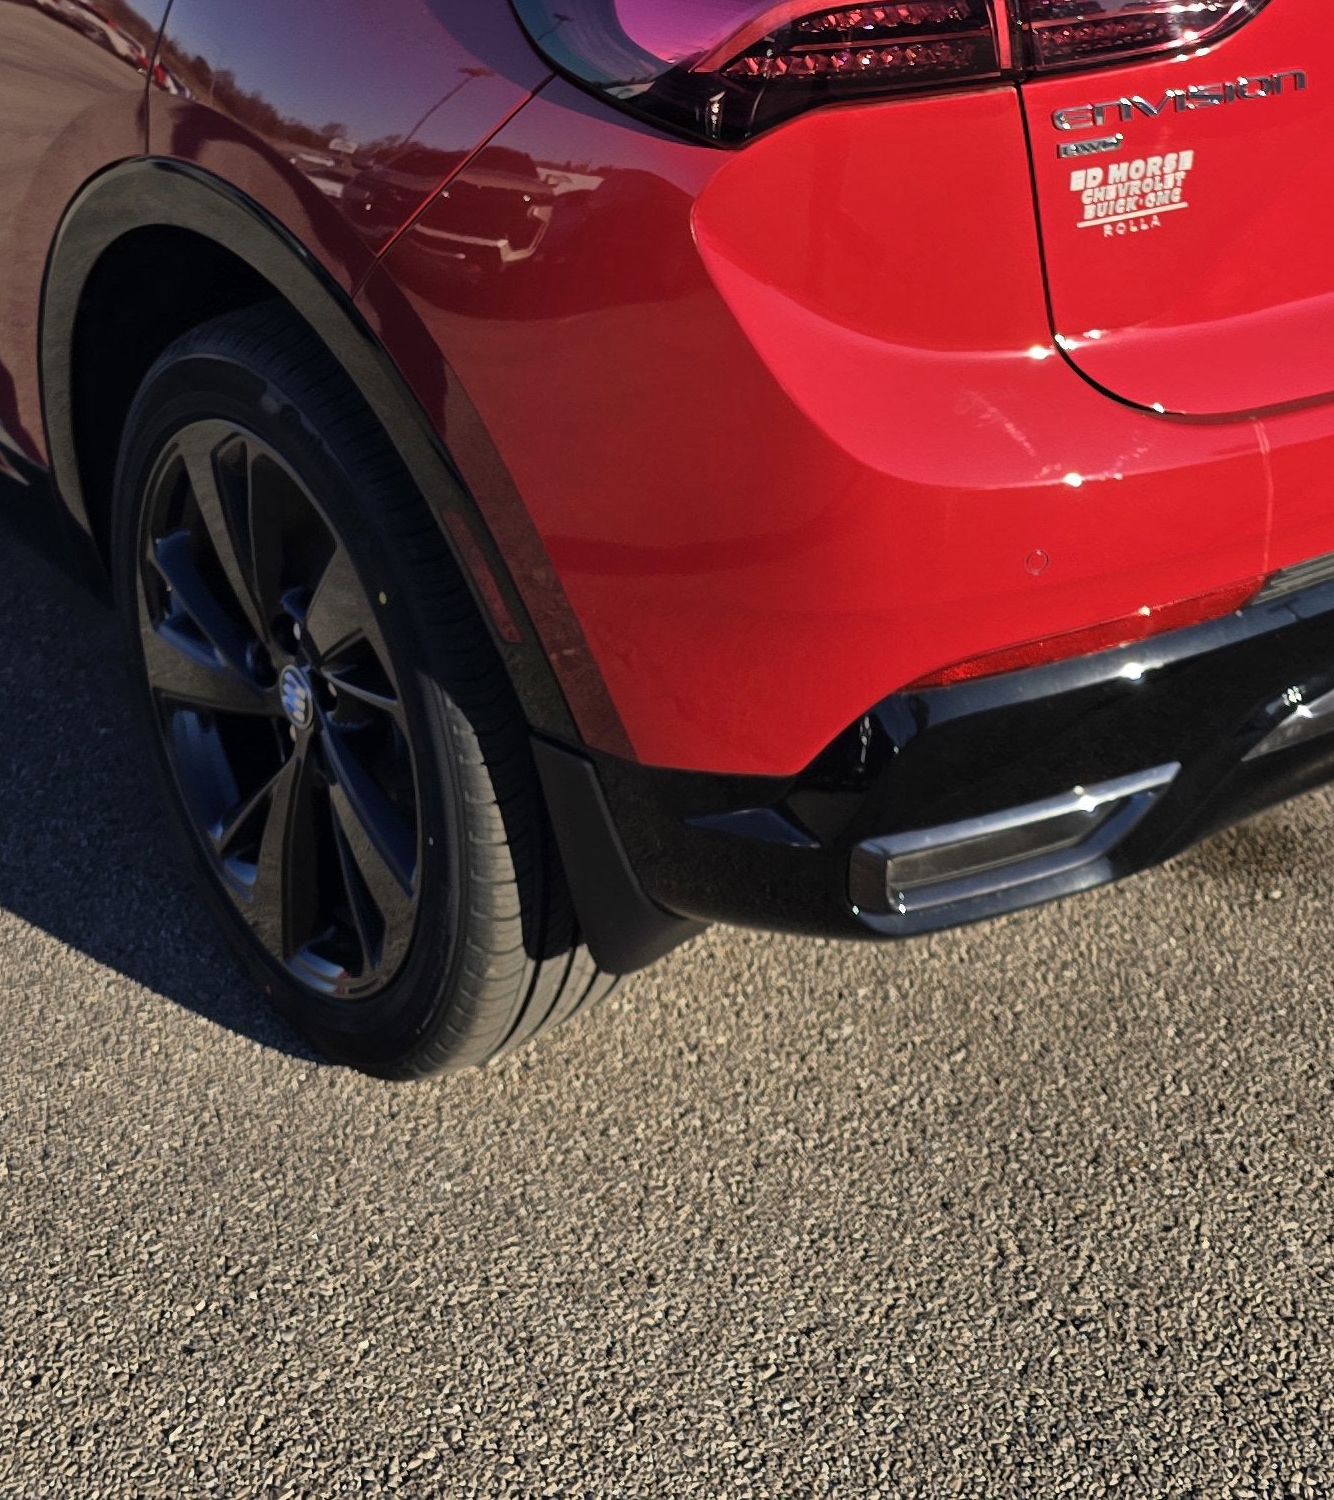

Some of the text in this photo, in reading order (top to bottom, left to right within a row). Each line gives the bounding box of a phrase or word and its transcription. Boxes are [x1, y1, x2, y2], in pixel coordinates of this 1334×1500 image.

[1070, 150, 1195, 191] ED MORSE
[1081, 171, 1186, 204] CHEVROLET
[1103, 215, 1162, 238] ROLLA
